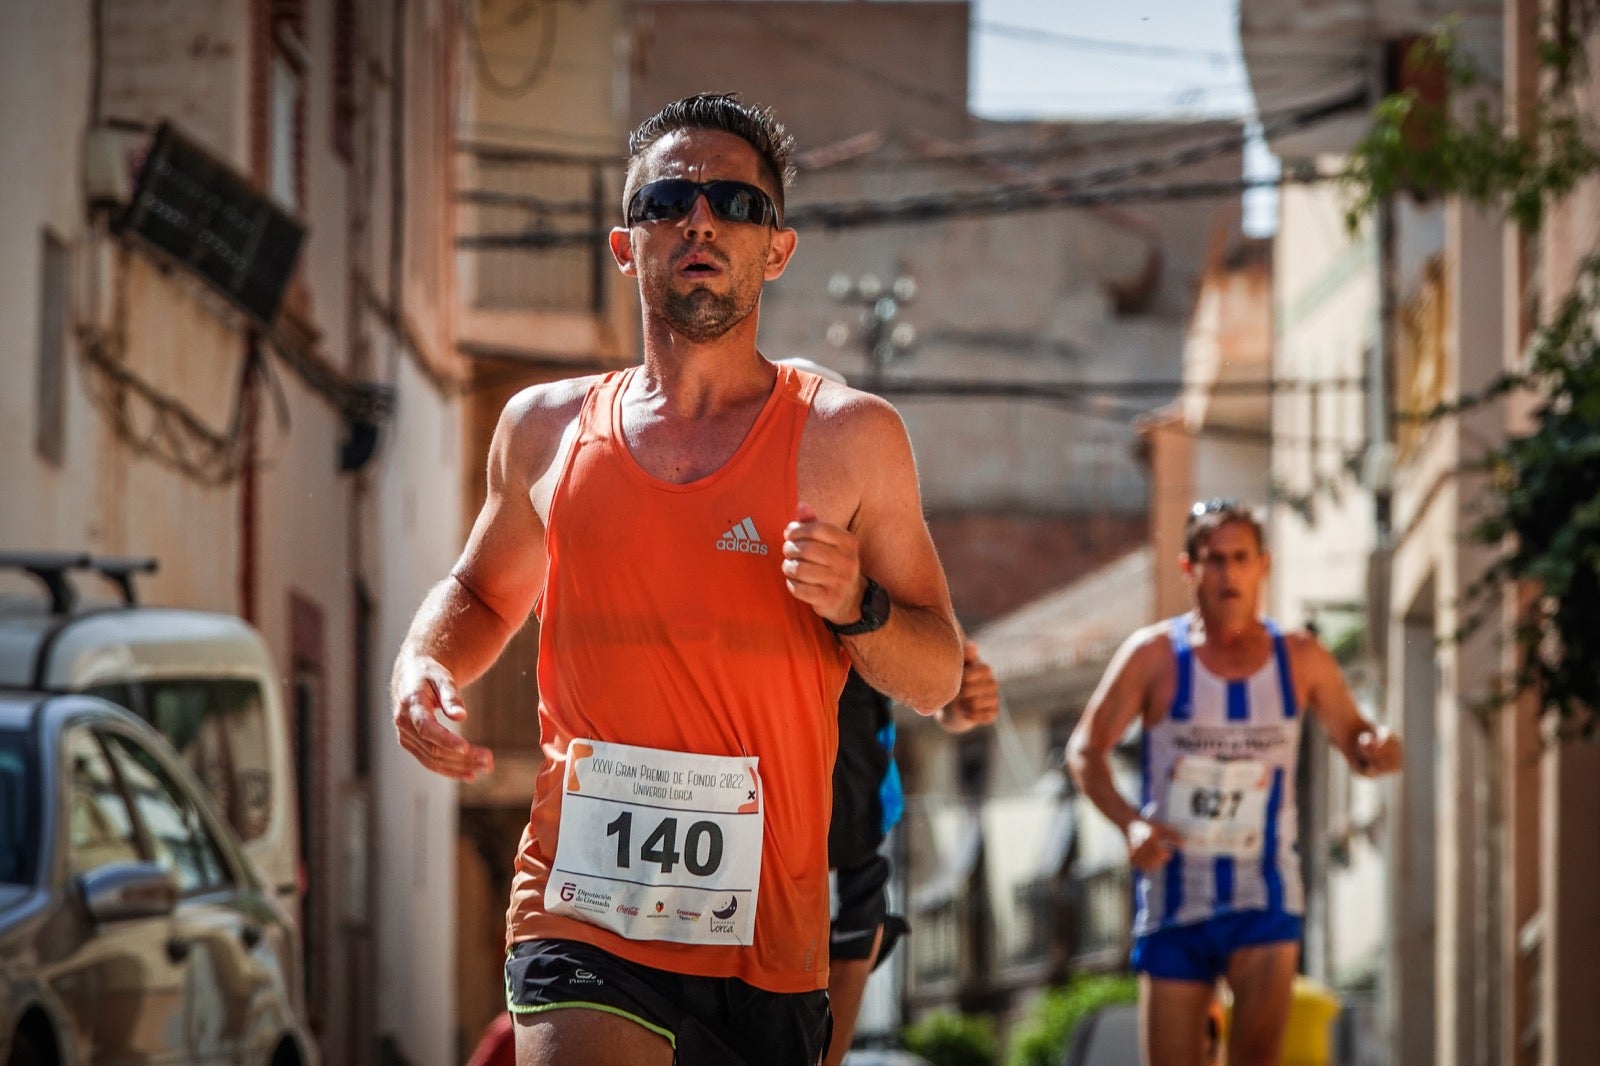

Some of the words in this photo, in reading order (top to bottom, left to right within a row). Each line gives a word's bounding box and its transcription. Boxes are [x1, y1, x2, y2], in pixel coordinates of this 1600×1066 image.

[716, 538, 768, 555] adidas
[591, 758, 613, 776] XXXV
[719, 773, 744, 789] 2022
[606, 811, 723, 877] 140
